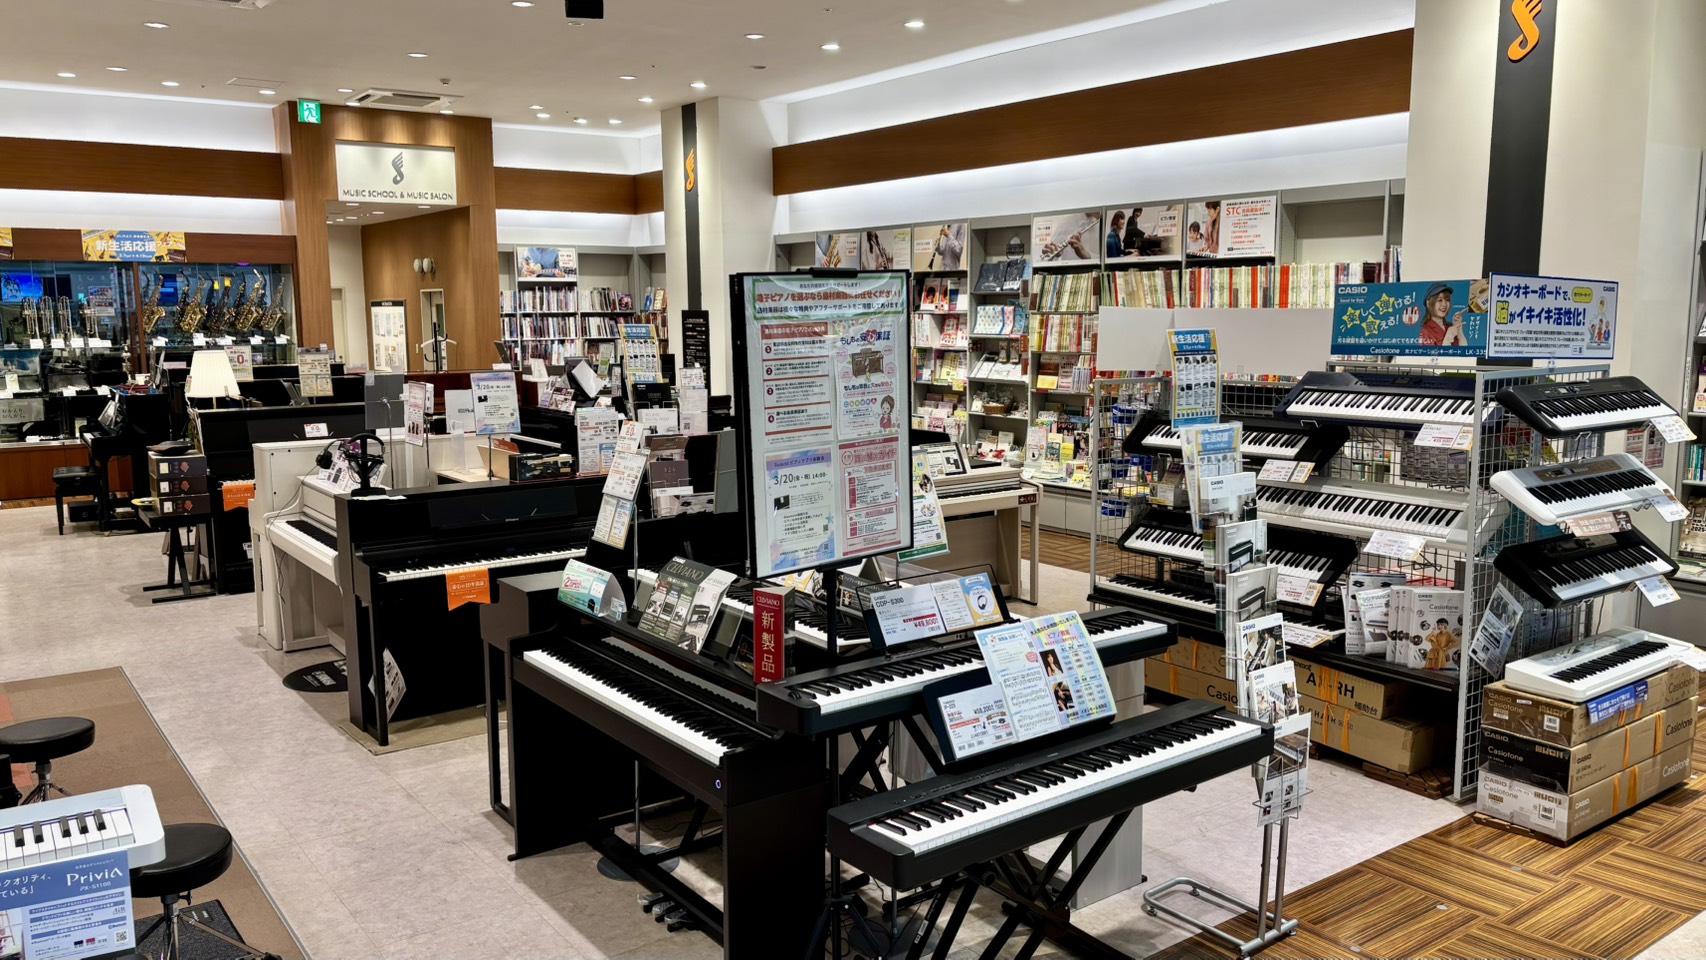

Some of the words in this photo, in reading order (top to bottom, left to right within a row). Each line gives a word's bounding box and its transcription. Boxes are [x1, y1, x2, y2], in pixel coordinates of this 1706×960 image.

[342, 189, 366, 198] MUSIC
[368, 190, 398, 198] SCHOOL
[406, 192, 428, 200] MUSIC
[1226, 207, 1241, 216] STC
[1338, 286, 1368, 294] CASIO
[1496, 282, 1571, 301] カシオキーボードで、
[1370, 346, 1400, 354] Casiotone
[666, 562, 704, 580] CELVIANO
[756, 596, 780, 607] CELVIANO
[1242, 622, 1256, 632] CASIO
[762, 610, 775, 674] 新製品
[1254, 673, 1264, 681] CASIO
[1668, 676, 1696, 694] Casiotone
[1206, 684, 1238, 704] Casio
[1488, 692, 1512, 703] CASIO
[1354, 701, 1378, 716] 補助台
[1488, 698, 1524, 714] Casiotone
[1666, 718, 1693, 736] Casiotone
[1484, 731, 1508, 742] CASIO
[1488, 746, 1524, 762] Casiotone
[1577, 753, 1592, 764] CASIO
[1662, 758, 1690, 778] Casiotone
[1484, 776, 1507, 788] CASIO
[1483, 784, 1519, 800] Casiotone
[1575, 798, 1590, 810] CASIO
[80, 881, 112, 892] PX-S1100
